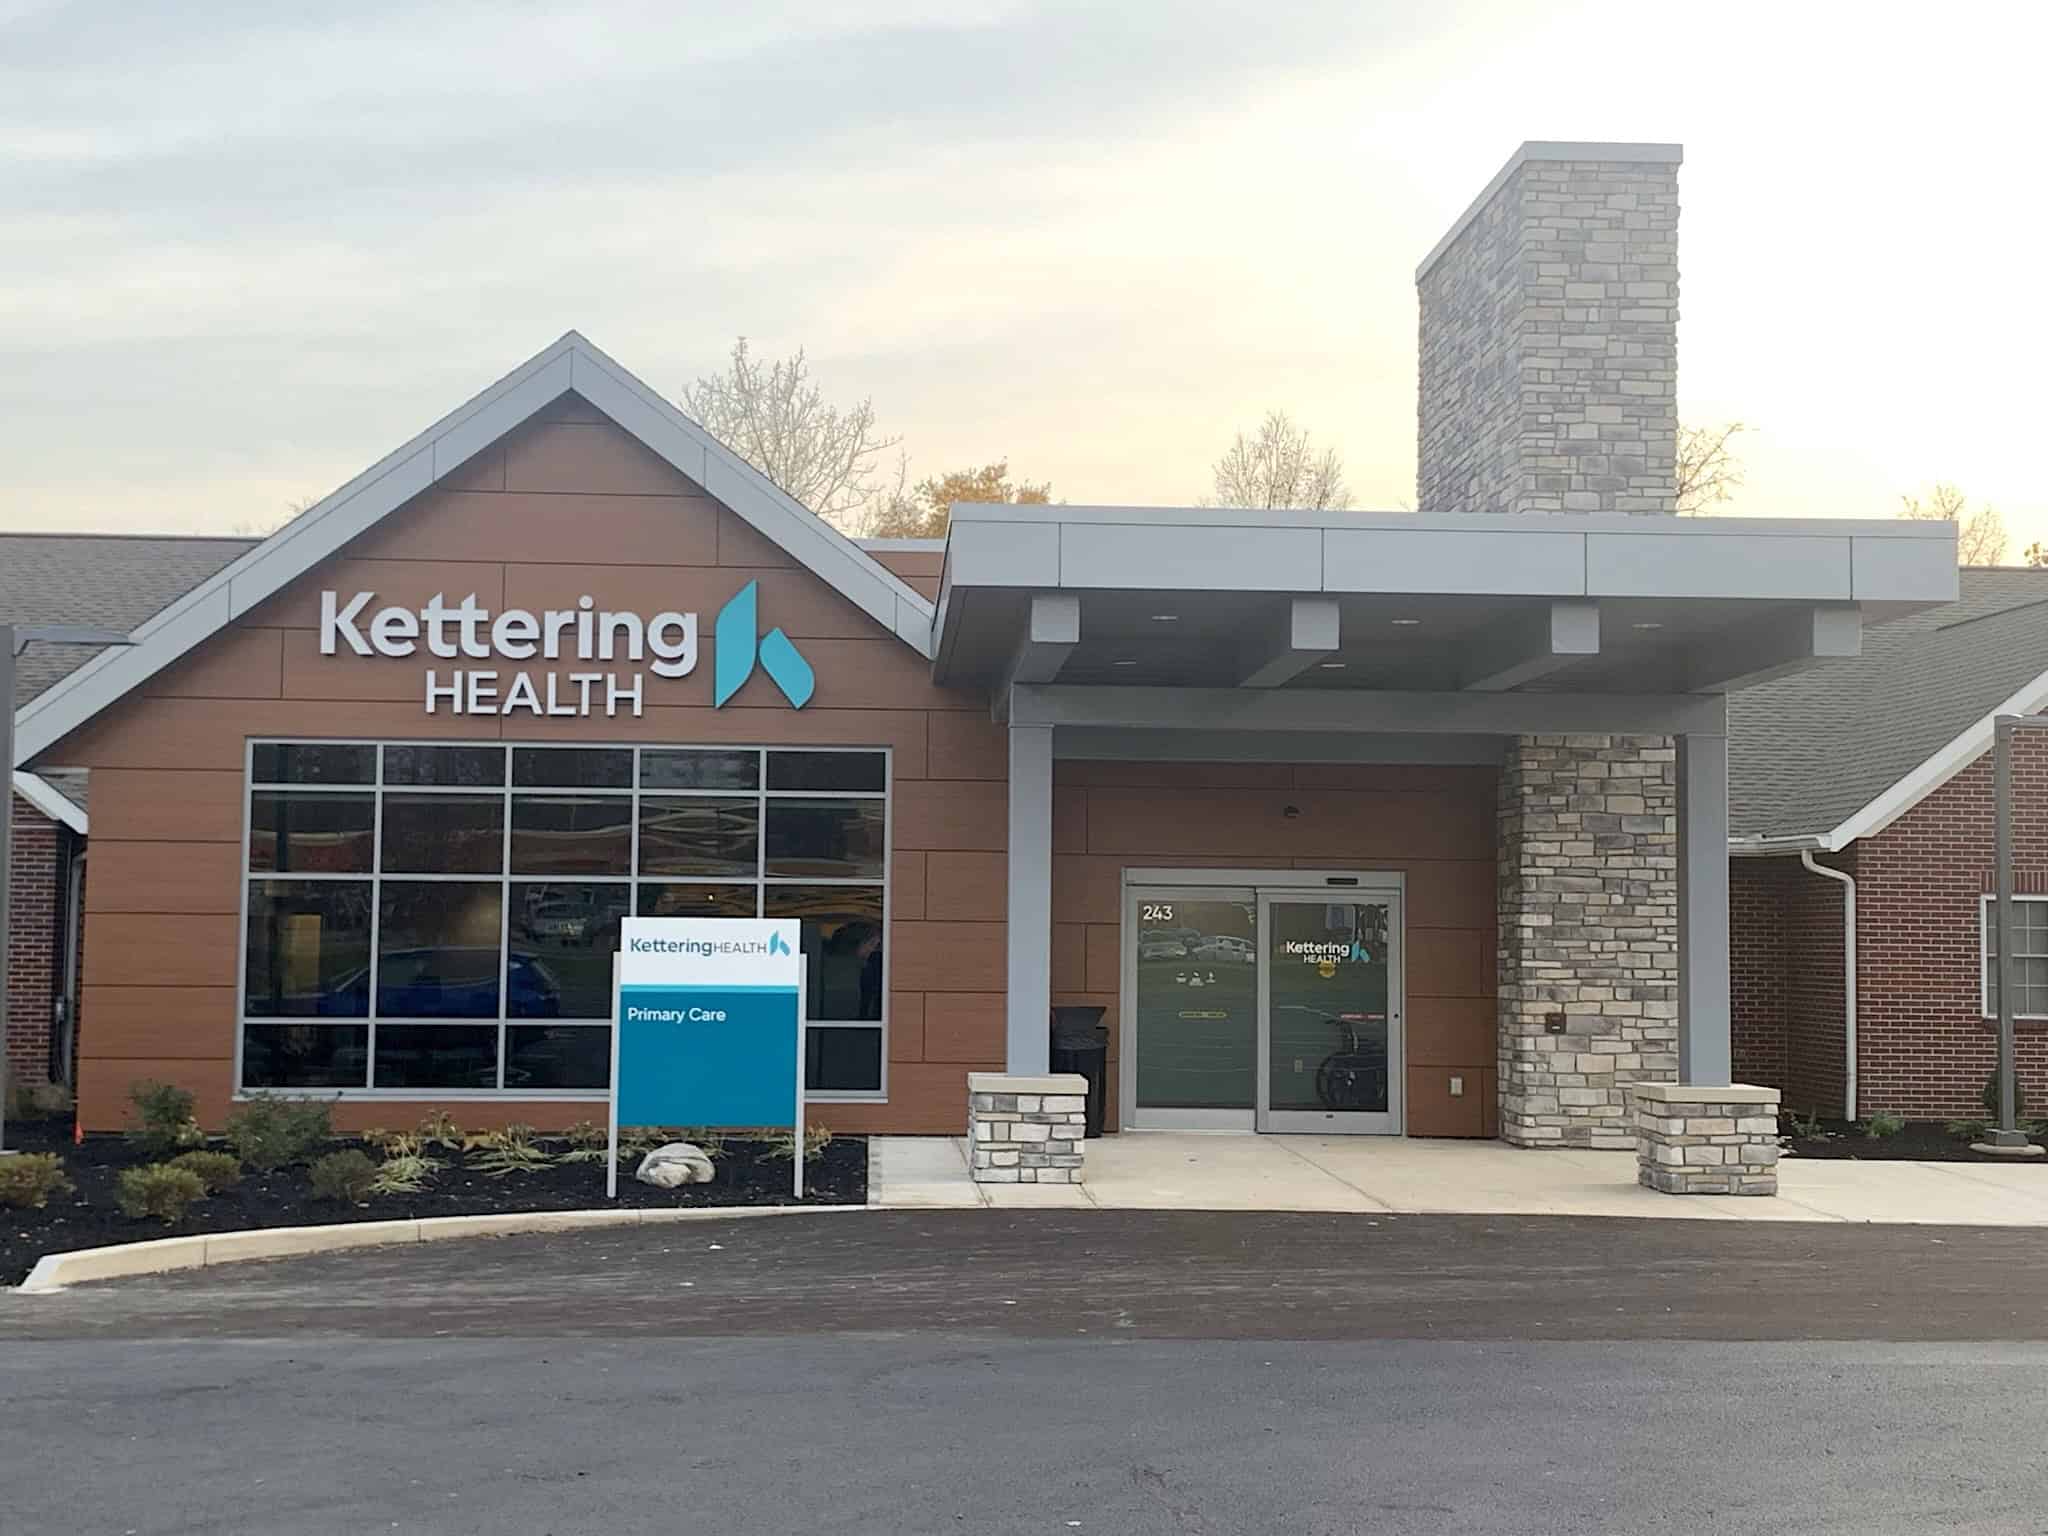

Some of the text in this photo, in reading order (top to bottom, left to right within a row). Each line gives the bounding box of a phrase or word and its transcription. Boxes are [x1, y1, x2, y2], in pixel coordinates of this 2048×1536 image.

[319, 590, 699, 678] Kettering
[425, 670, 644, 717] HEALTH
[1143, 905, 1173, 920] 243
[1286, 941, 1350, 957] Kettering
[1303, 954, 1341, 963] HEALTH
[627, 1007, 727, 1024] Primary Care
